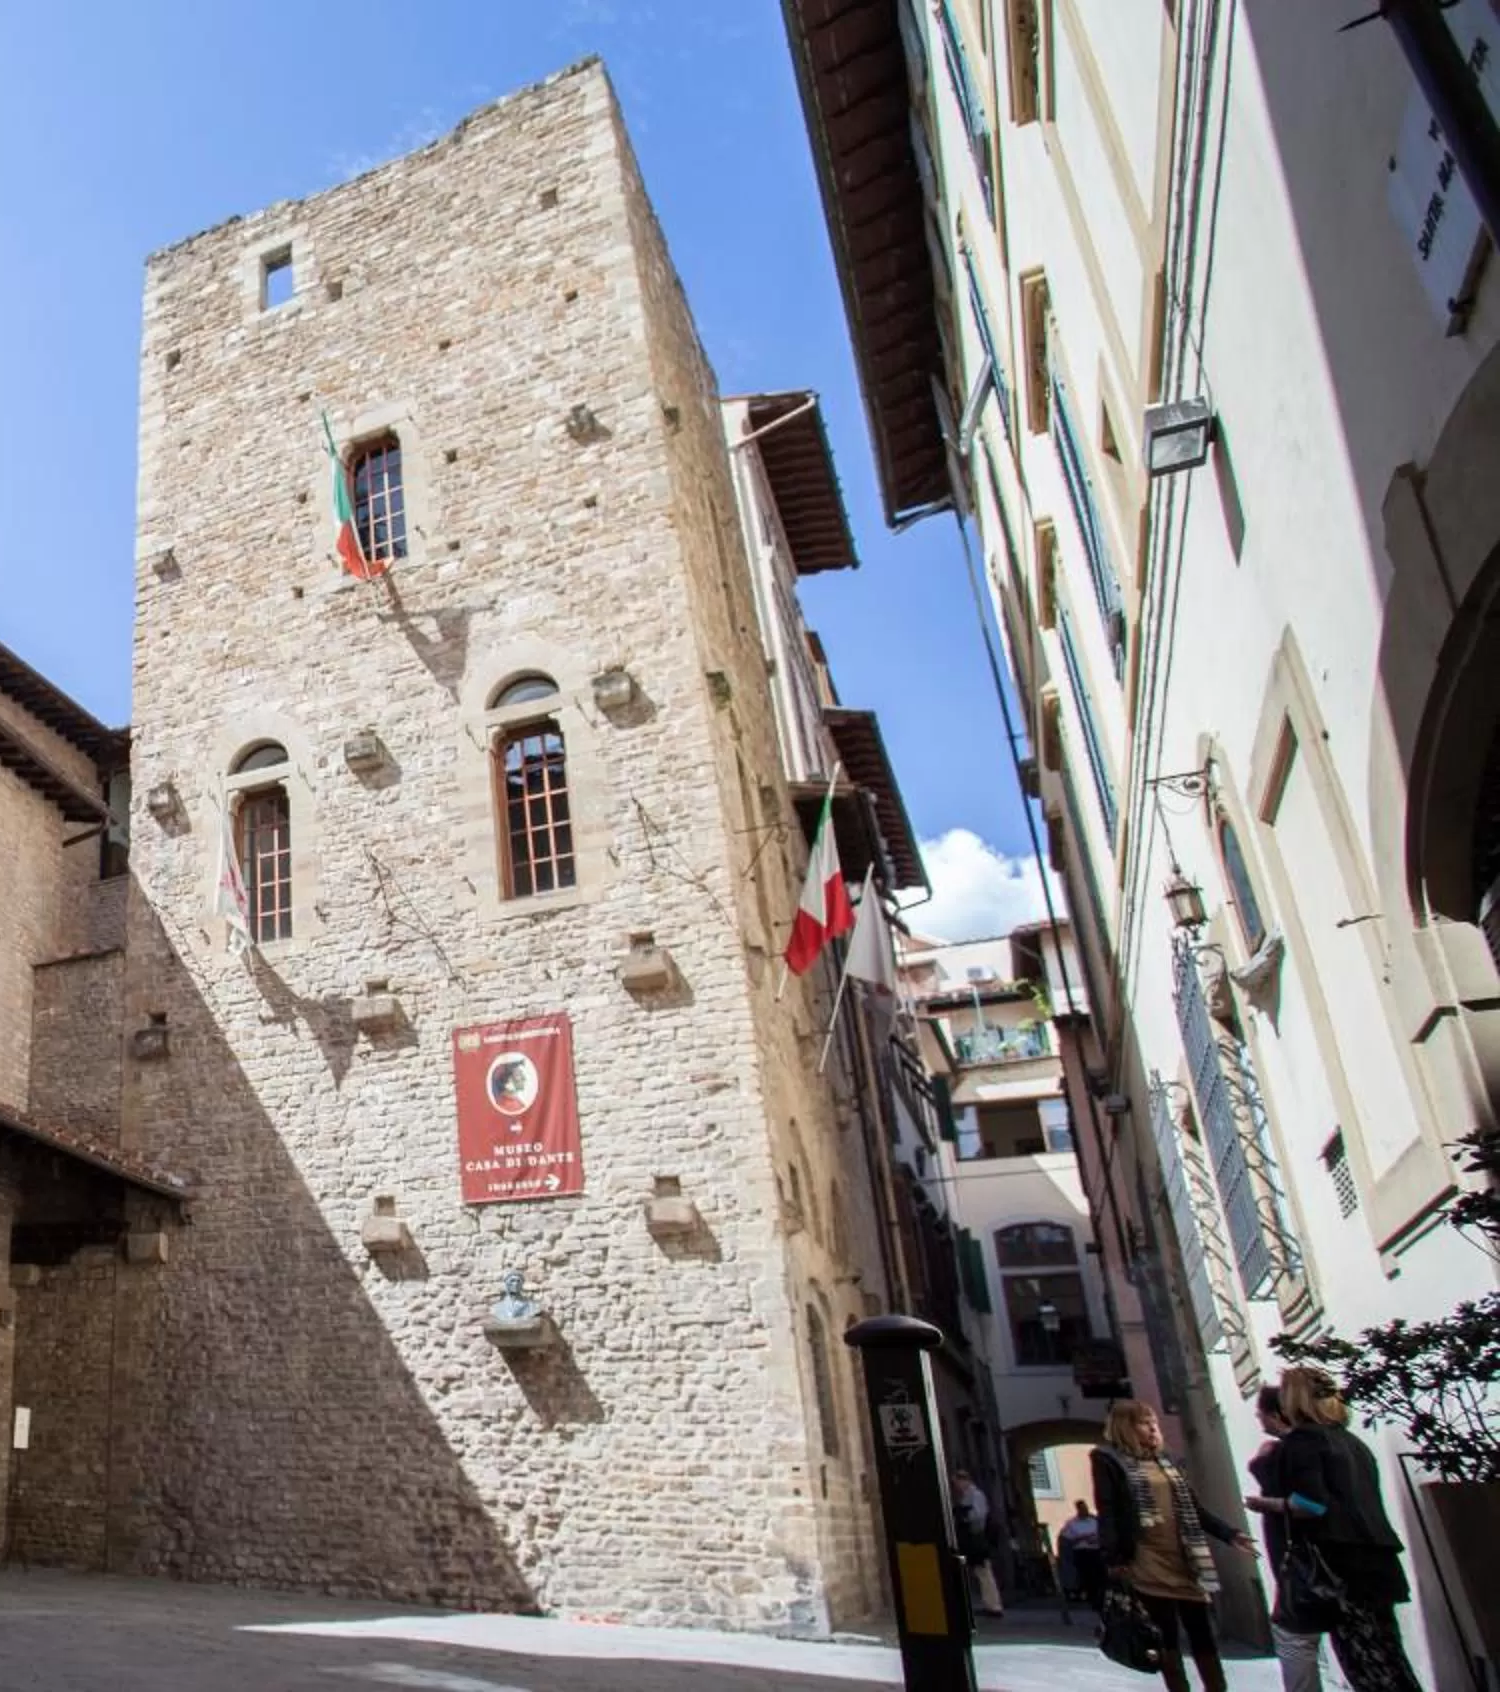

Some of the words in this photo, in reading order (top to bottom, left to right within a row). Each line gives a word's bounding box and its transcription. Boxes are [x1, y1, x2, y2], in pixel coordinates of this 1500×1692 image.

[494, 1143, 543, 1156] MUSEO
[465, 1160, 501, 1173] CASA
[505, 1157, 522, 1169] DI
[527, 1151, 574, 1167] DANTE
